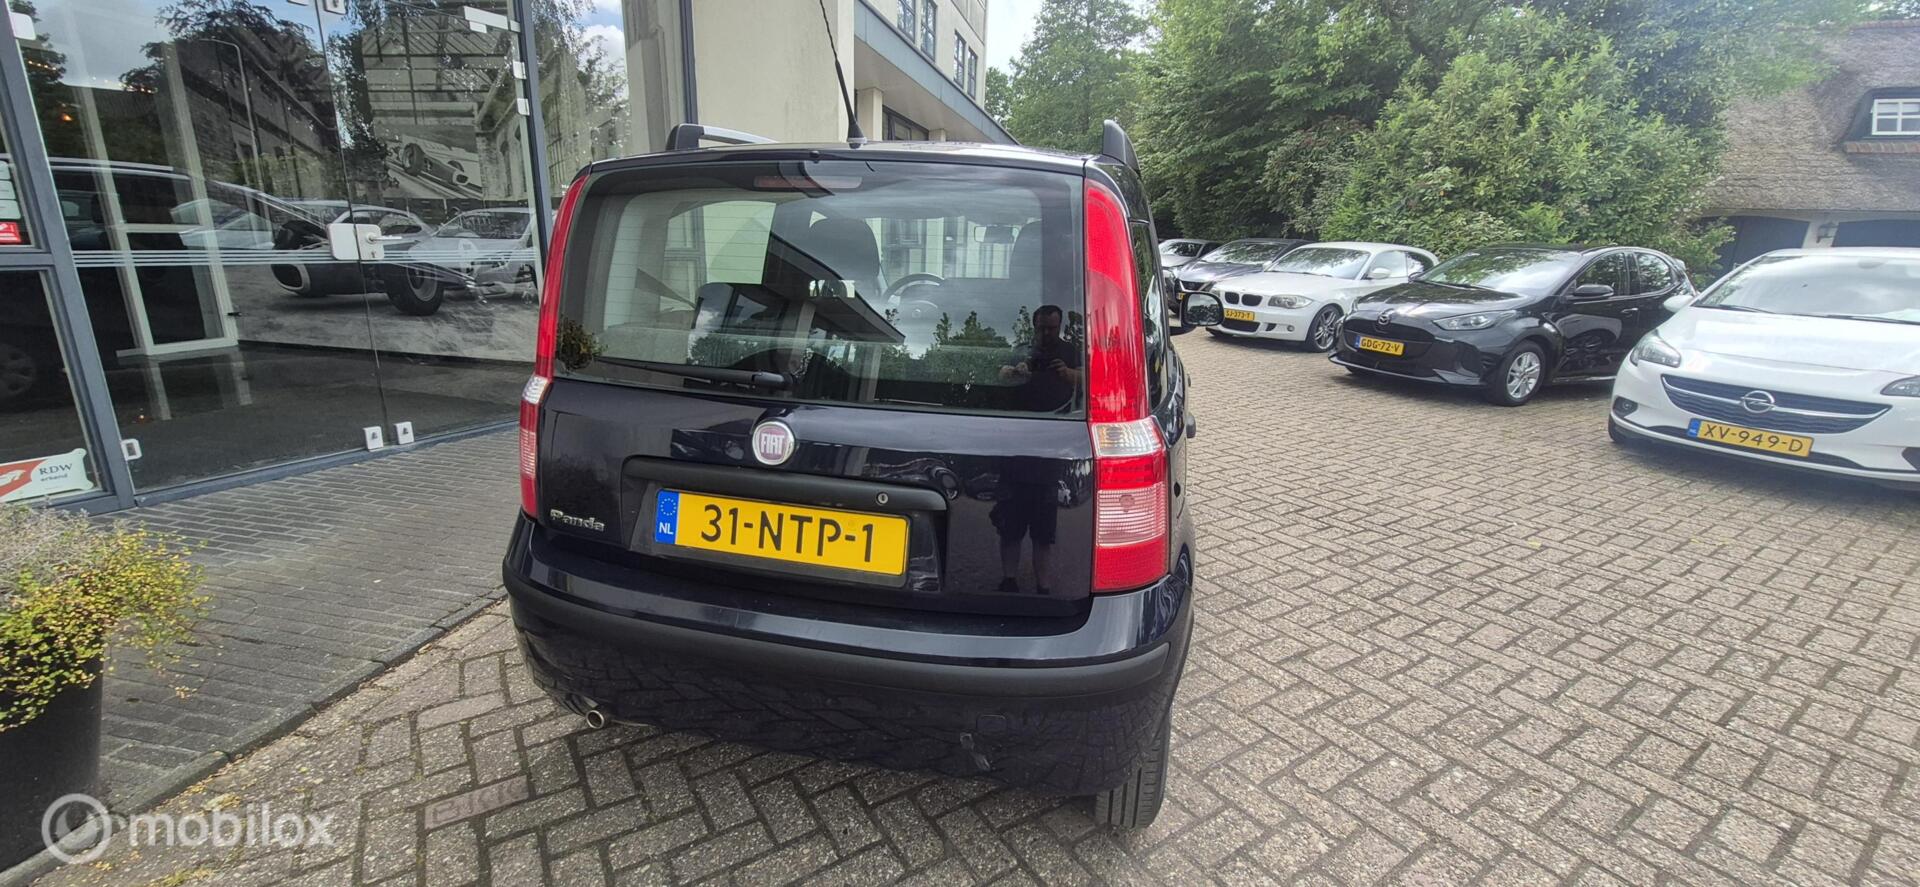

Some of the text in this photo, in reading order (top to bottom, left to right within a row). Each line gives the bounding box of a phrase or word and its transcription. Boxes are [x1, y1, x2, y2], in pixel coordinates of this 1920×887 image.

[1361, 339, 1400, 352] GDG-72-V
[761, 433, 785, 454] FIAT
[1704, 424, 1803, 452] XV-949-D
[39, 463, 73, 476] RDW
[550, 509, 605, 531] Panda
[659, 504, 874, 562] NL 31-NTP-1
